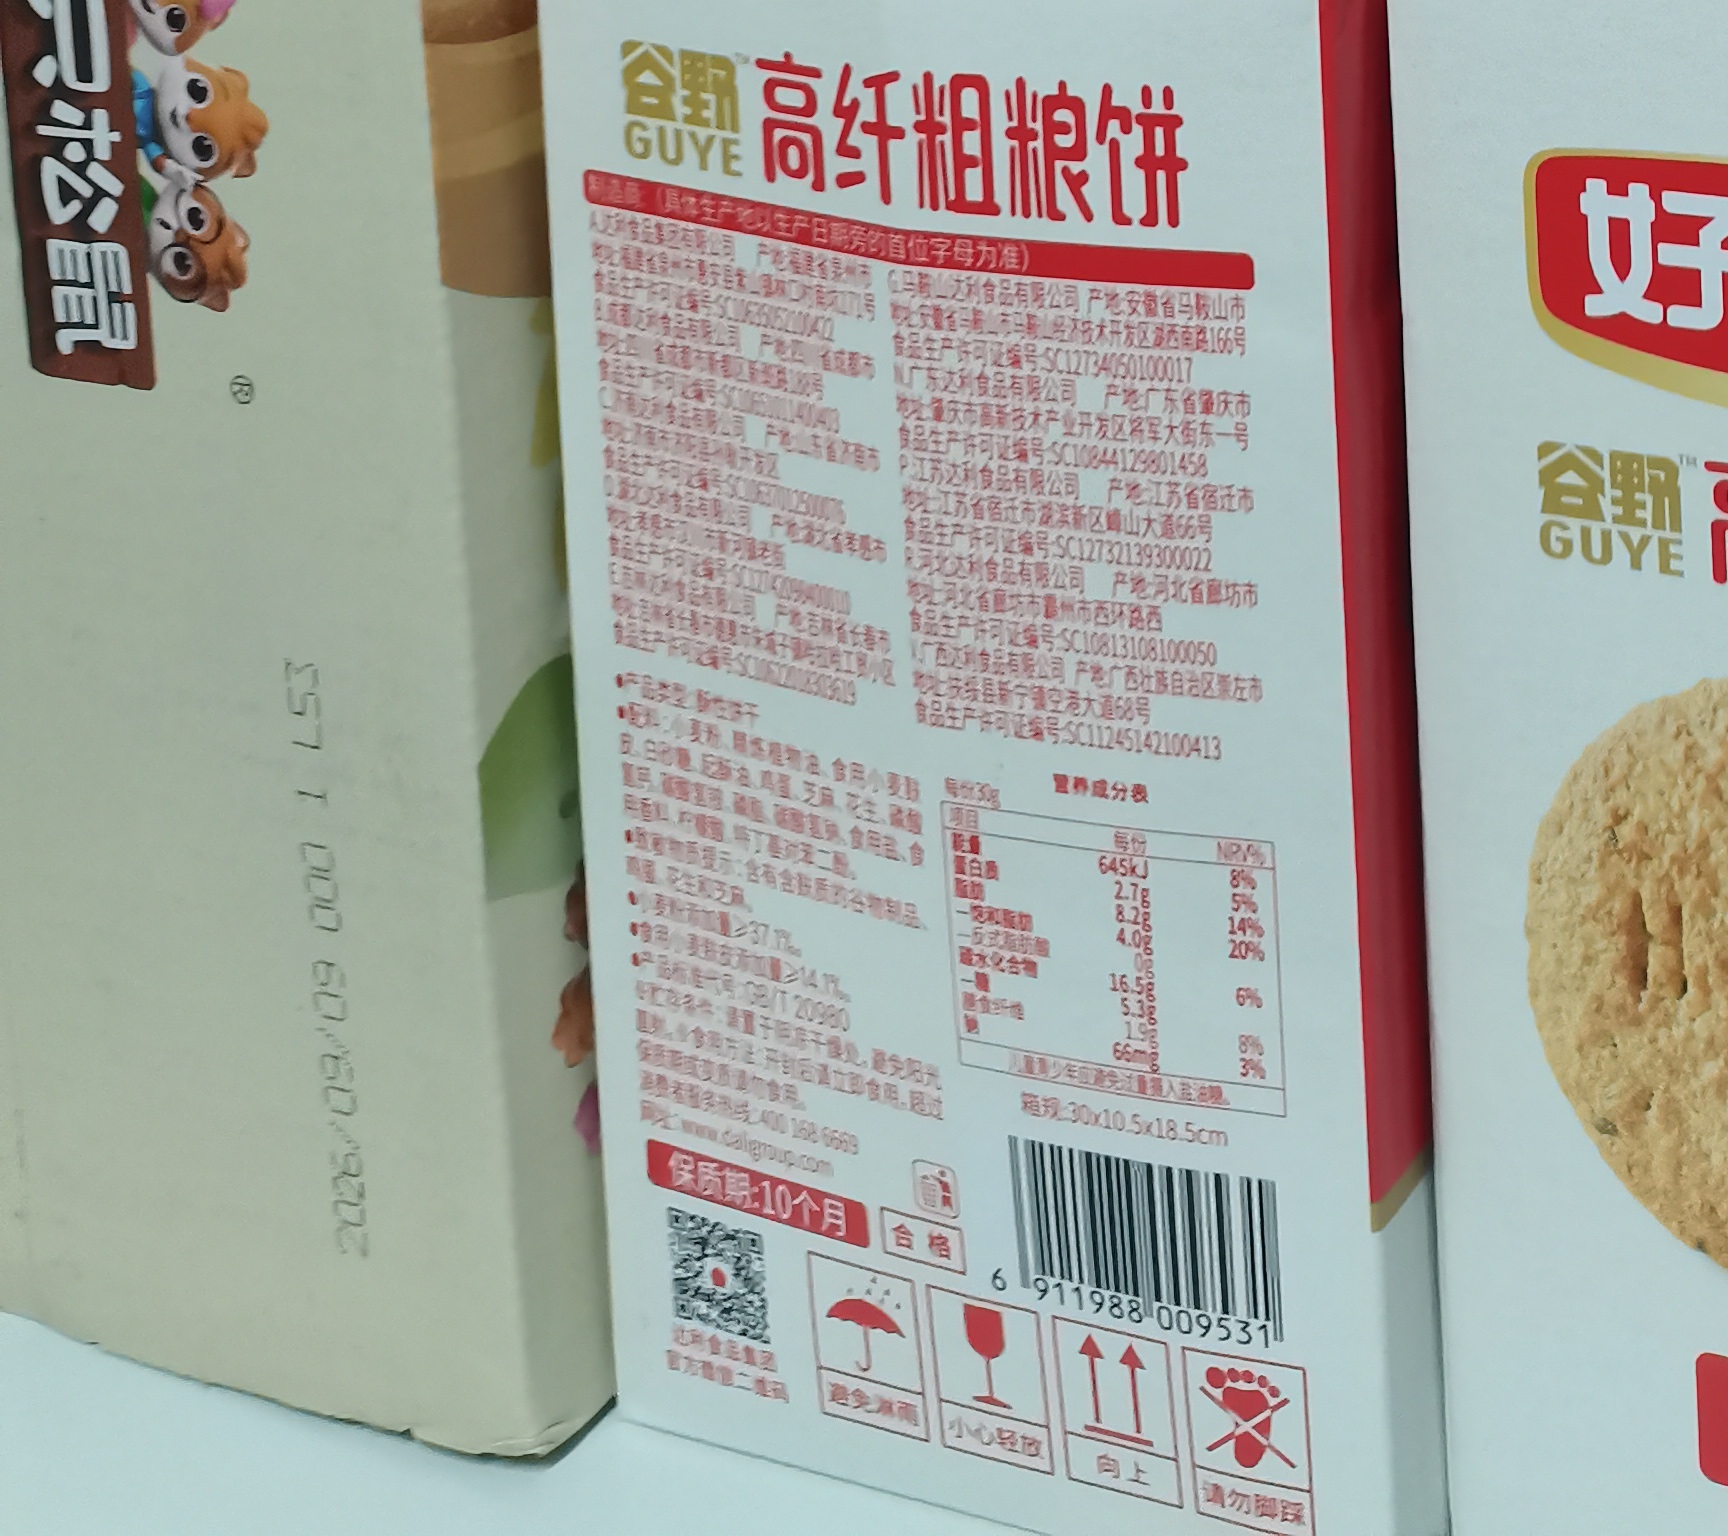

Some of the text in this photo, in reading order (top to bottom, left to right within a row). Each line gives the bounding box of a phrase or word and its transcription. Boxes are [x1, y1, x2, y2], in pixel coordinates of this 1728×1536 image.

[626, 117, 743, 178] GUYE
[755, 51, 1189, 229] 高纤粗粮饼
[1538, 440, 1683, 537] 谷野
[1538, 516, 1685, 579] GUYE
[991, 1268, 1272, 1350] 6 911988 009531
